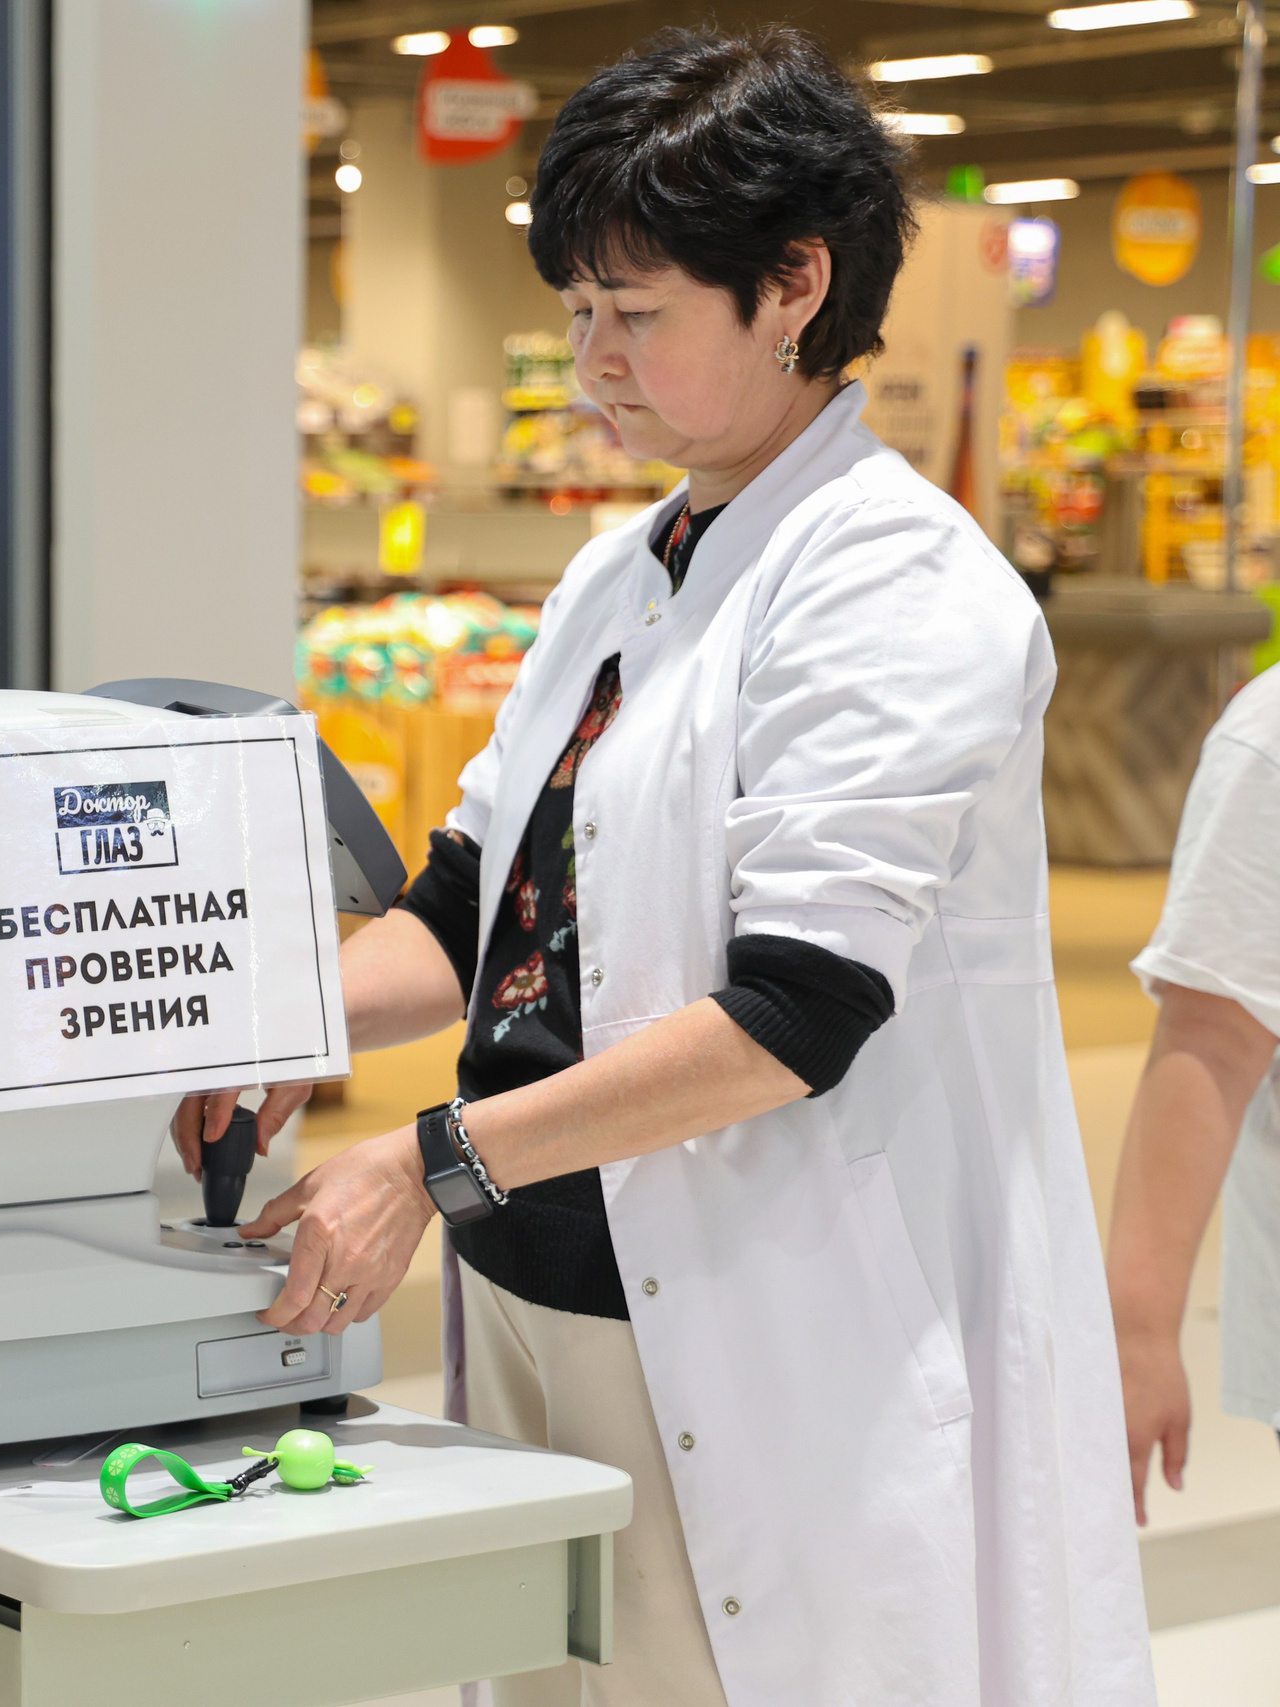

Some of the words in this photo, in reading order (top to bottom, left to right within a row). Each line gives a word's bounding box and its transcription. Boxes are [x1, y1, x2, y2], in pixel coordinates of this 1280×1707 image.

[58, 788, 151, 823] Доктор
[80, 825, 144, 866] ГЛАЗ
[25, 941, 234, 990] ПРОВЕРКА
[60, 994, 210, 1040] ЗРЕНИЯ
